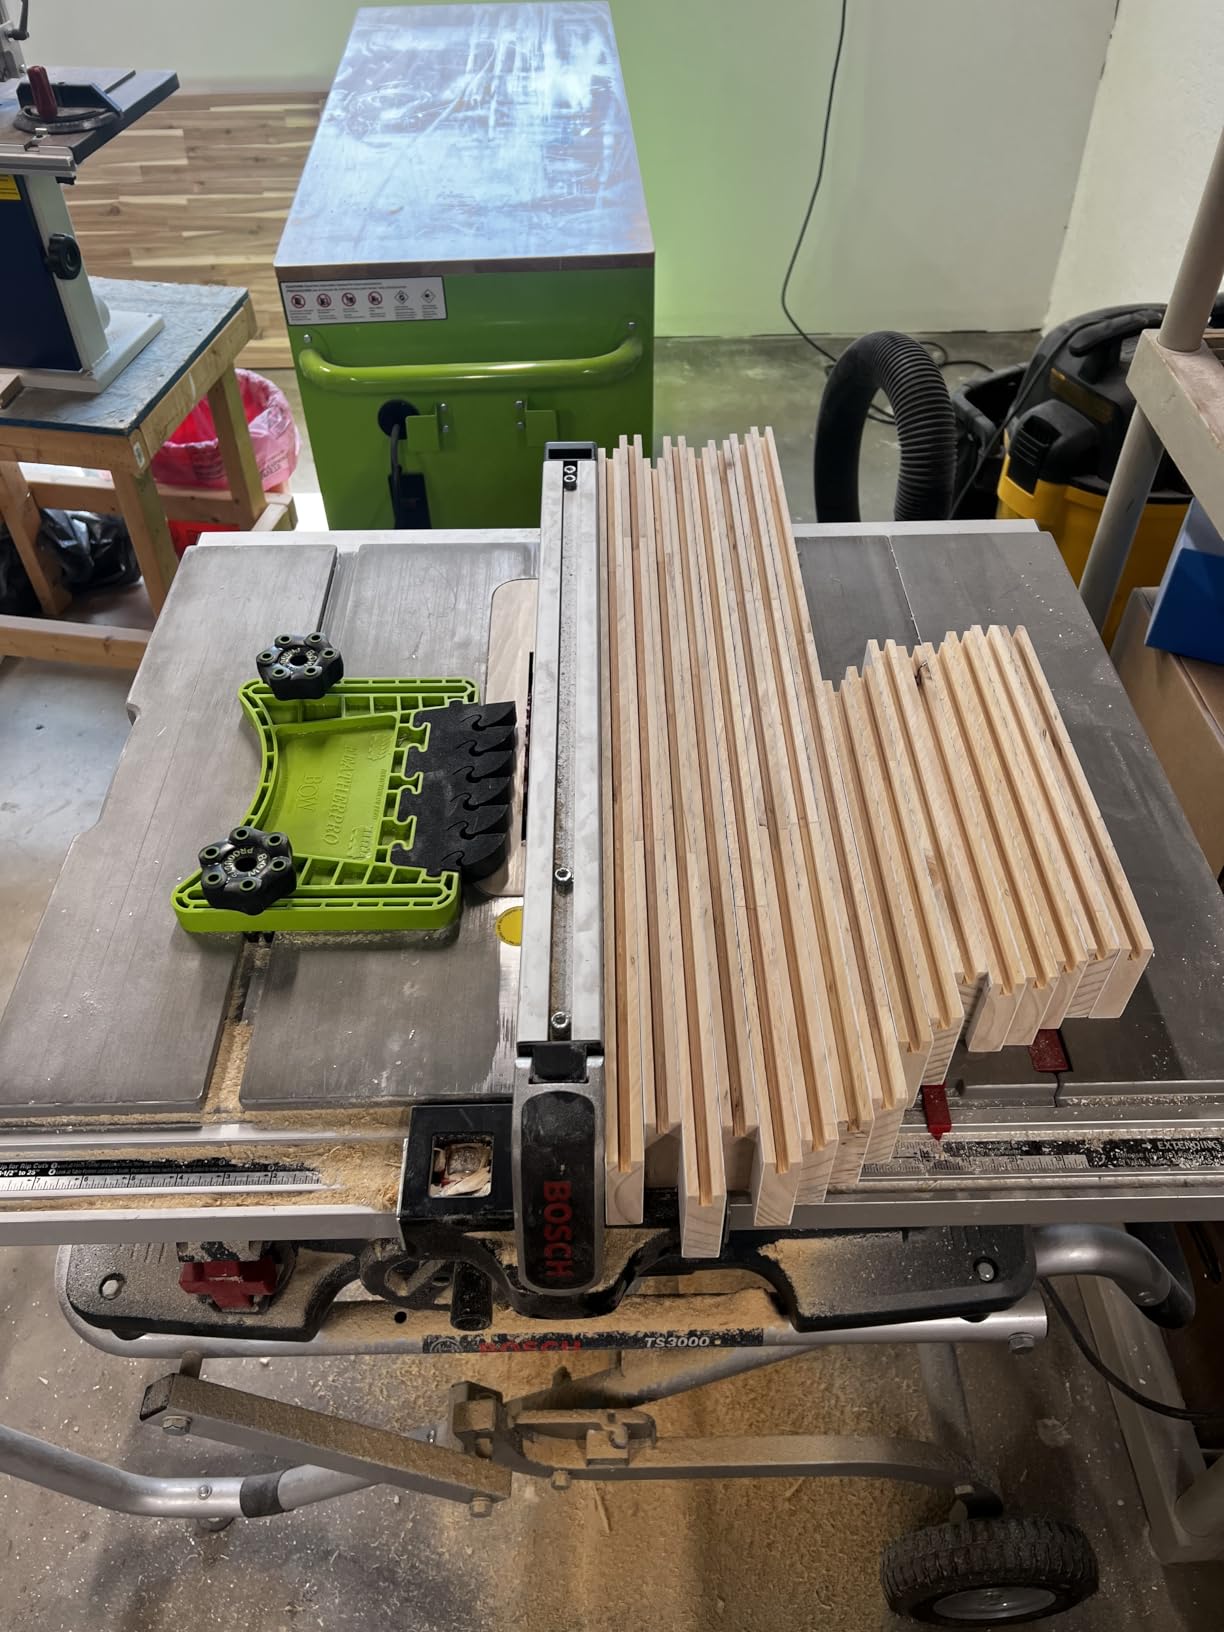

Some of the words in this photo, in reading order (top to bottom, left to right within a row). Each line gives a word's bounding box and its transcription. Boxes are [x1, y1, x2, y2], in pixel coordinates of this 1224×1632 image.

[296, 775, 322, 812] BOW
[1157, 1140, 1221, 1150] EXTENDING
[543, 1181, 573, 1277] BOSCH
[645, 1336, 710, 1348] TS3000
